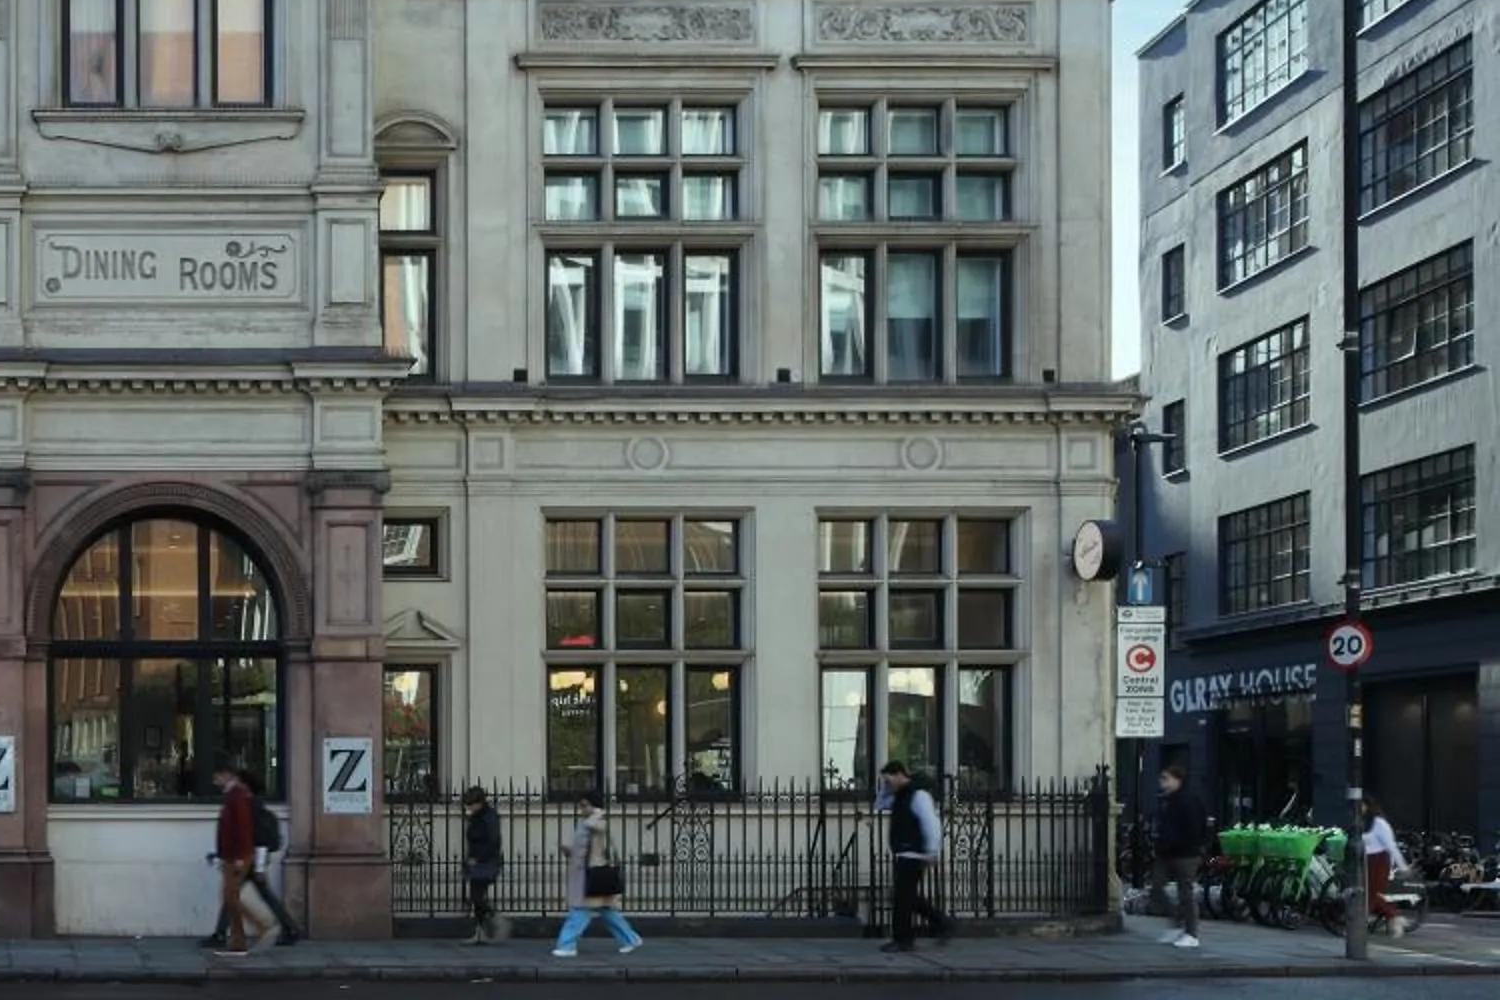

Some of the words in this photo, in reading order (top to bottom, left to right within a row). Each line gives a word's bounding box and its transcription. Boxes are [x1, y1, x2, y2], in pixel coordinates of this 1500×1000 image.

[50, 242, 157, 280] DINING
[179, 257, 278, 291] ROOMS
[1333, 635, 1363, 656] 20
[328, 749, 367, 793] Z
